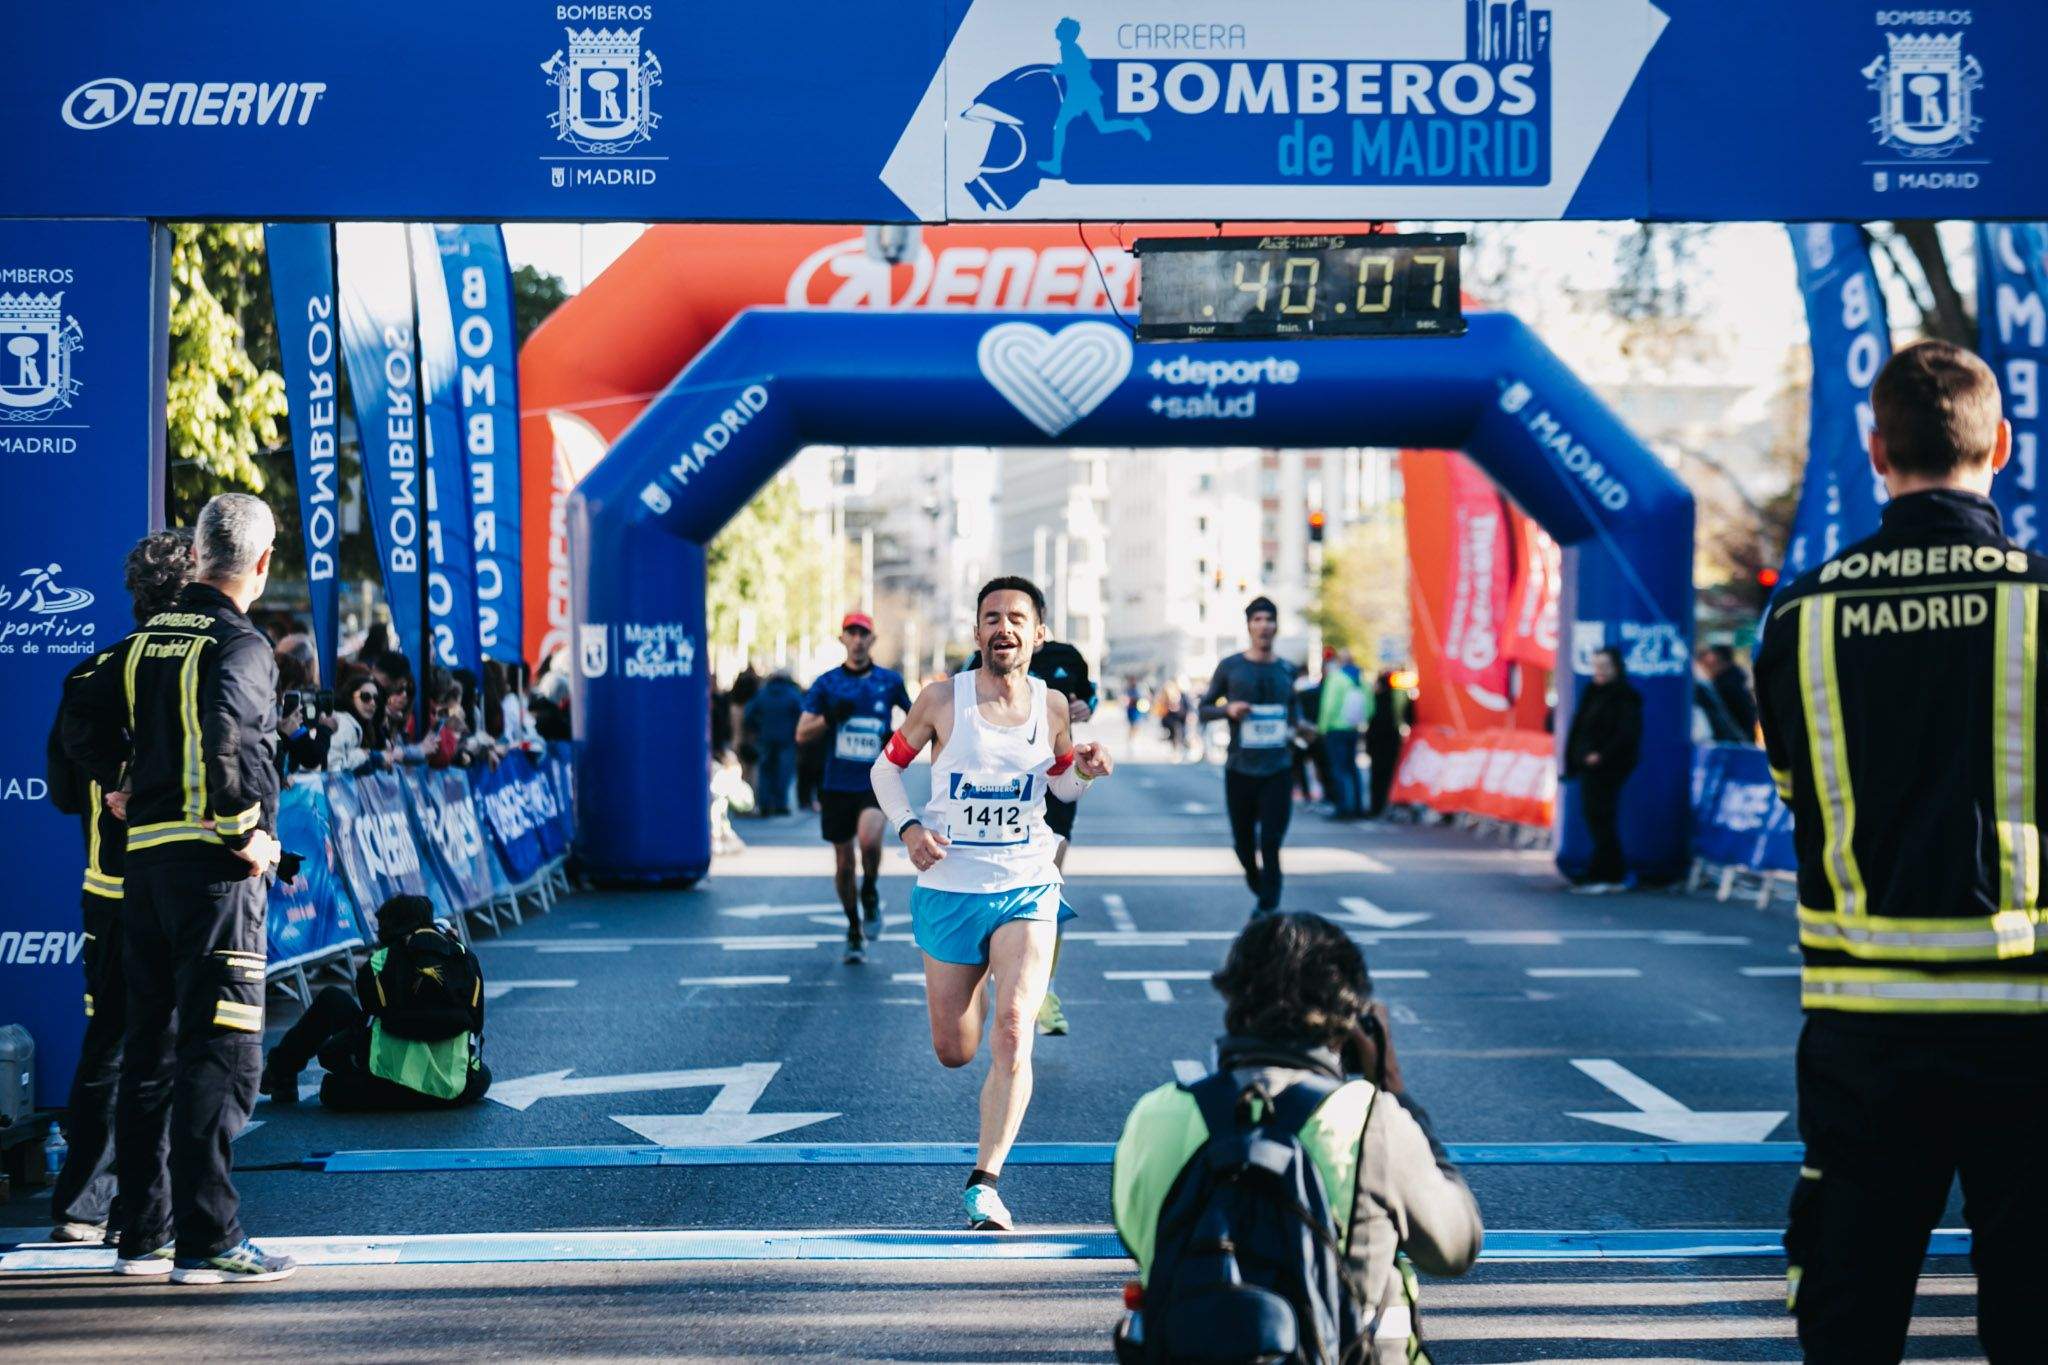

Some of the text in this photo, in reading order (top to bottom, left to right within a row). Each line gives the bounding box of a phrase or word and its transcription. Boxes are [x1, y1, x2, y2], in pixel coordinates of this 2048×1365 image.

[556, 5, 653, 21] BOMBEROS
[1876, 10, 1972, 26] BOMBEROS
[1117, 23, 1246, 50] CARRERA
[1117, 62, 1536, 115] BOMBEROS
[134, 82, 326, 126] ENERVIT
[1278, 121, 1538, 177] de MADRID
[577, 168, 656, 186] MADRID
[1899, 172, 1979, 190] MADRID
[927, 247, 1141, 312] ENER
[1189, 324, 1217, 335] hour
[1416, 320, 1441, 331] sec.
[0, 437, 78, 454] MADRID
[670, 384, 769, 485] MADRID
[1529, 410, 1630, 512] MADRID
[1819, 544, 2028, 585] BOMBEROS
[0, 615, 95, 643] portivo
[145, 612, 216, 630] BOMBEROS
[1841, 593, 1988, 639] MADRID
[22, 640, 40, 654] de
[47, 640, 96, 654] madrid
[144, 639, 192, 658] madrid
[963, 805, 1020, 826] 1412
[0, 931, 87, 964] NERV
